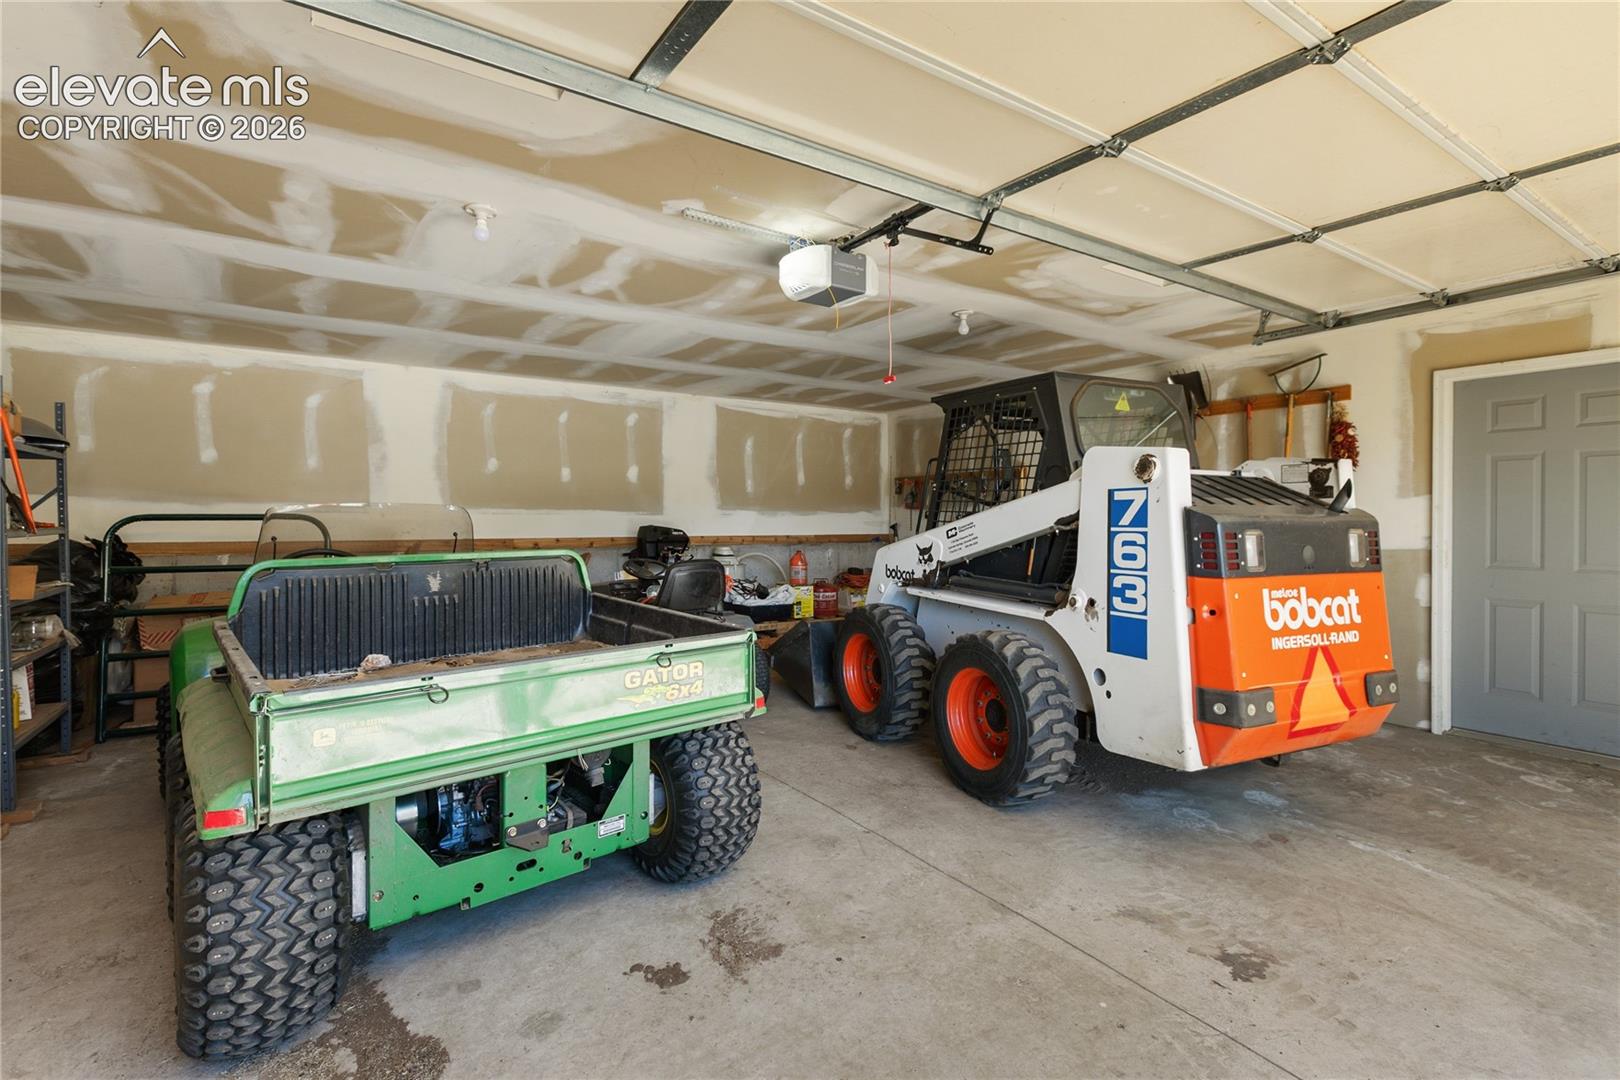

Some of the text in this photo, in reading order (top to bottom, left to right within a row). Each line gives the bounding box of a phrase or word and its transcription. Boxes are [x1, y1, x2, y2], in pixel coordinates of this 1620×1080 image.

[1112, 490, 1148, 613] 763
[885, 564, 915, 581] bobcat
[1262, 587, 1361, 631] bobcat
[1271, 630, 1360, 650] INGERSOLL-RAND
[624, 660, 704, 689] GATOR
